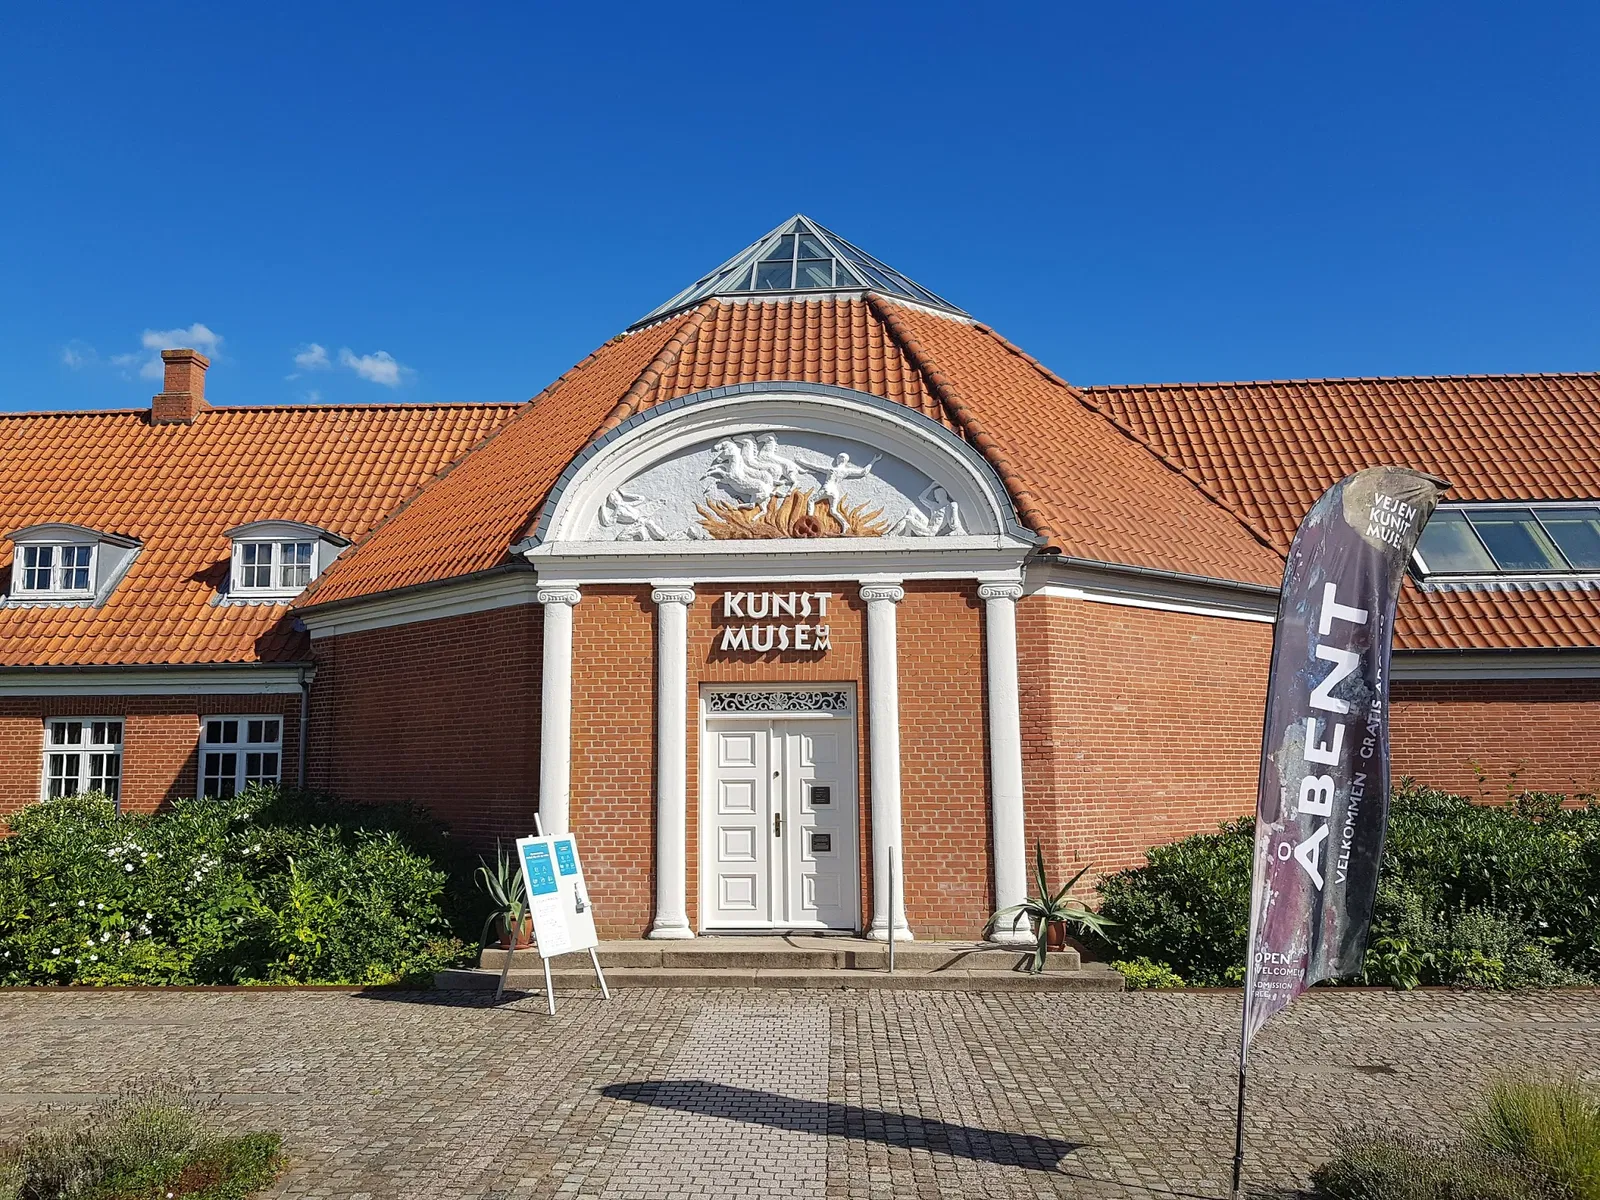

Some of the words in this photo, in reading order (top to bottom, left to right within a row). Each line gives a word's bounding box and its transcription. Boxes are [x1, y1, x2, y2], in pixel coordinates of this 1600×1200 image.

[1374, 492, 1417, 522] VEJEN
[1369, 507, 1411, 536] KUNST
[723, 591, 832, 619] KUNST
[720, 624, 832, 652] MUSEUM
[1334, 771, 1367, 885] VELKOMMEN
[1359, 699, 1382, 759] GRATIS
[1254, 953, 1290, 965] OPEN
[1252, 989, 1270, 998] REE
